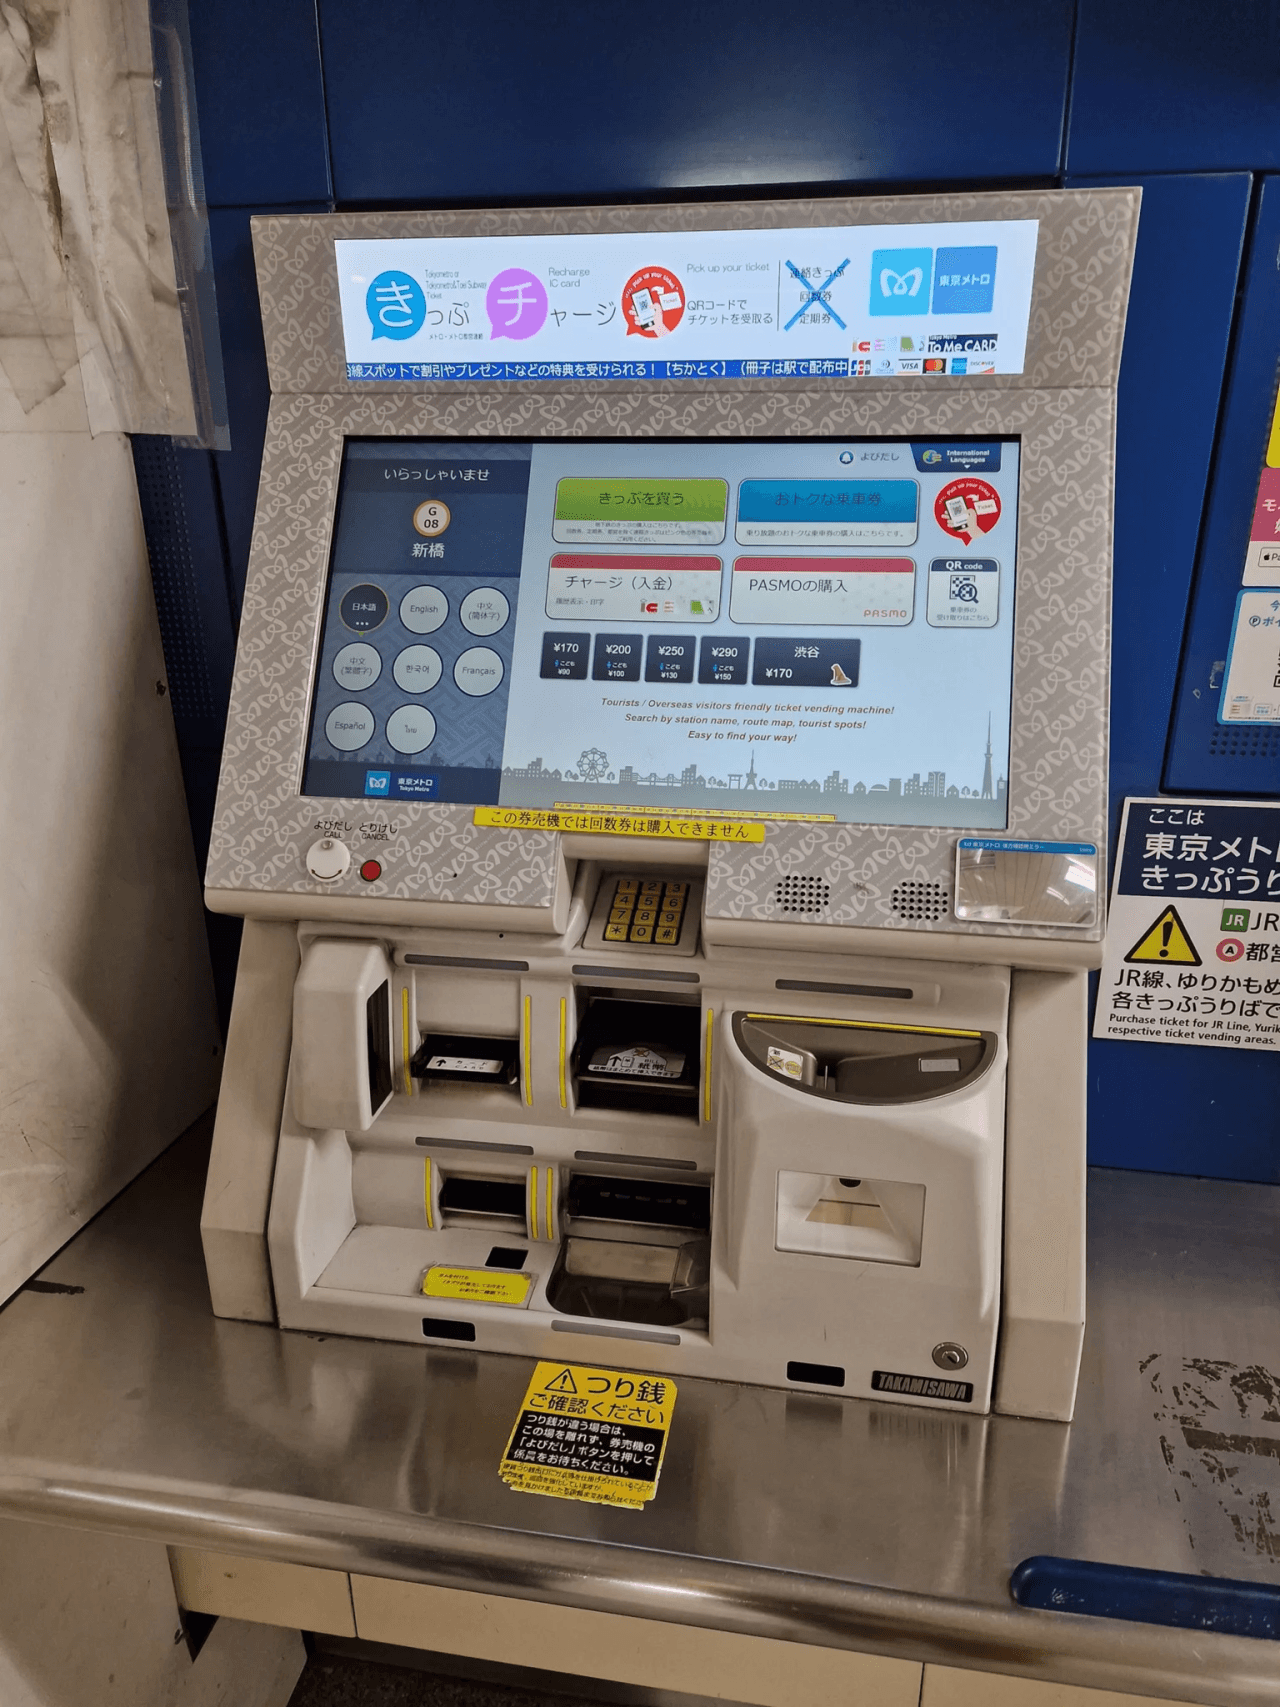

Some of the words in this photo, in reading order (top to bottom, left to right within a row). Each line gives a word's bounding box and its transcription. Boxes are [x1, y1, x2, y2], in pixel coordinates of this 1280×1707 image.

[548, 267, 590, 278] Recharge
[687, 263, 705, 273] Pick
[708, 266, 721, 274] up
[722, 265, 744, 274] your
[746, 263, 770, 272] ticket
[550, 279, 557, 288] IC
[559, 278, 580, 288] card
[940, 273, 990, 287] 東京メトロ
[688, 300, 747, 311] QRコードで
[688, 313, 773, 325] チケットを受取る
[799, 313, 831, 324] 定期券
[928, 342, 940, 353] To
[943, 341, 962, 352] Me
[964, 339, 997, 352] CARD
[902, 362, 919, 371] VISA
[861, 452, 899, 462] よびだし
[950, 457, 985, 465] Languages
[385, 468, 490, 482] いらっしゃいませ
[599, 492, 684, 506] きっぷを買う
[775, 492, 882, 507] おトクな乗車券
[429, 507, 437, 517] G
[424, 519, 439, 529] 08
[411, 542, 445, 559] 新橋
[946, 560, 962, 571] QR
[964, 562, 983, 570] code
[565, 576, 673, 591] チャージ（入金）
[749, 578, 848, 593] PASMOの購入
[352, 603, 377, 612] 日本語
[410, 605, 438, 615] English
[476, 602, 493, 611] 中文
[864, 609, 907, 618] PASMO
[554, 642, 579, 654] ¥170
[606, 644, 631, 655] ¥200
[659, 645, 684, 657] ¥250
[712, 646, 738, 658] ¥290
[794, 645, 820, 659] 渋谷
[350, 658, 366, 666] 中文
[406, 665, 430, 675] 한국어
[462, 667, 496, 677] Français
[608, 670, 625, 678] ¥100
[661, 672, 678, 680] ¥130
[766, 668, 792, 679] ¥170
[715, 673, 731, 681] ¥150
[601, 698, 639, 707] Tourists
[648, 699, 692, 710] Overseas
[696, 700, 732, 711] visitors
[734, 701, 771, 714] friendly
[774, 703, 802, 713] ticket
[804, 704, 844, 716] vending
[847, 705, 894, 716] machine!
[334, 721, 366, 732] Español
[625, 712, 658, 723] Search
[660, 714, 672, 726] by
[674, 715, 706, 725] station
[708, 718, 739, 728] name,
[742, 718, 768, 727] route
[771, 720, 795, 730] map,
[798, 718, 831, 728] tourist
[834, 719, 867, 731] spots!
[688, 730, 713, 741] Easy
[715, 732, 724, 740] to
[726, 731, 746, 741] find
[748, 733, 772, 744] your
[773, 732, 797, 744] way!
[398, 778, 433, 787] 東京メトロ
[1149, 808, 1205, 826] ここは
[314, 821, 353, 832] よびだし
[359, 822, 398, 834] とりけし
[491, 810, 749, 839] この券売機では回数券は購入できません
[324, 831, 342, 839] CALL
[362, 833, 390, 841] CANCEL
[1142, 832, 1280, 863] 東京メト
[648, 882, 657, 891] 2
[673, 884, 681, 893] 3
[620, 896, 629, 904] 4
[645, 897, 653, 906] 5
[669, 899, 678, 908] 6
[617, 910, 627, 920] 7
[641, 912, 650, 921] 8
[666, 914, 675, 923] 9
[1226, 914, 1245, 927] JR
[637, 927, 646, 937] 0
[1225, 946, 1235, 955] A
[1112, 991, 1280, 1019] 各きっぷうりばで
[1109, 1014, 1156, 1025] Purchase
[1160, 1017, 1189, 1027] ticket
[1193, 1019, 1209, 1028] for
[1211, 1021, 1223, 1030] JR
[1227, 1021, 1251, 1033] Line,
[1108, 1026, 1162, 1038] respective
[1165, 1029, 1195, 1039] ticket
[1198, 1032, 1241, 1045] vending
[1245, 1036, 1277, 1045] areas.
[638, 1063, 666, 1071] 紙幣
[587, 1377, 667, 1406] つり銭
[879, 1373, 967, 1400] TAKAMISAWA
[530, 1393, 664, 1424] ご確認ください
[528, 1414, 626, 1437] つり銭が違う場合は、
[523, 1426, 655, 1453] この場を離れず、券売機の
[520, 1437, 655, 1466] 「よびだし」ボタンを押して
[513, 1448, 629, 1476] 係員をお待ちください。
